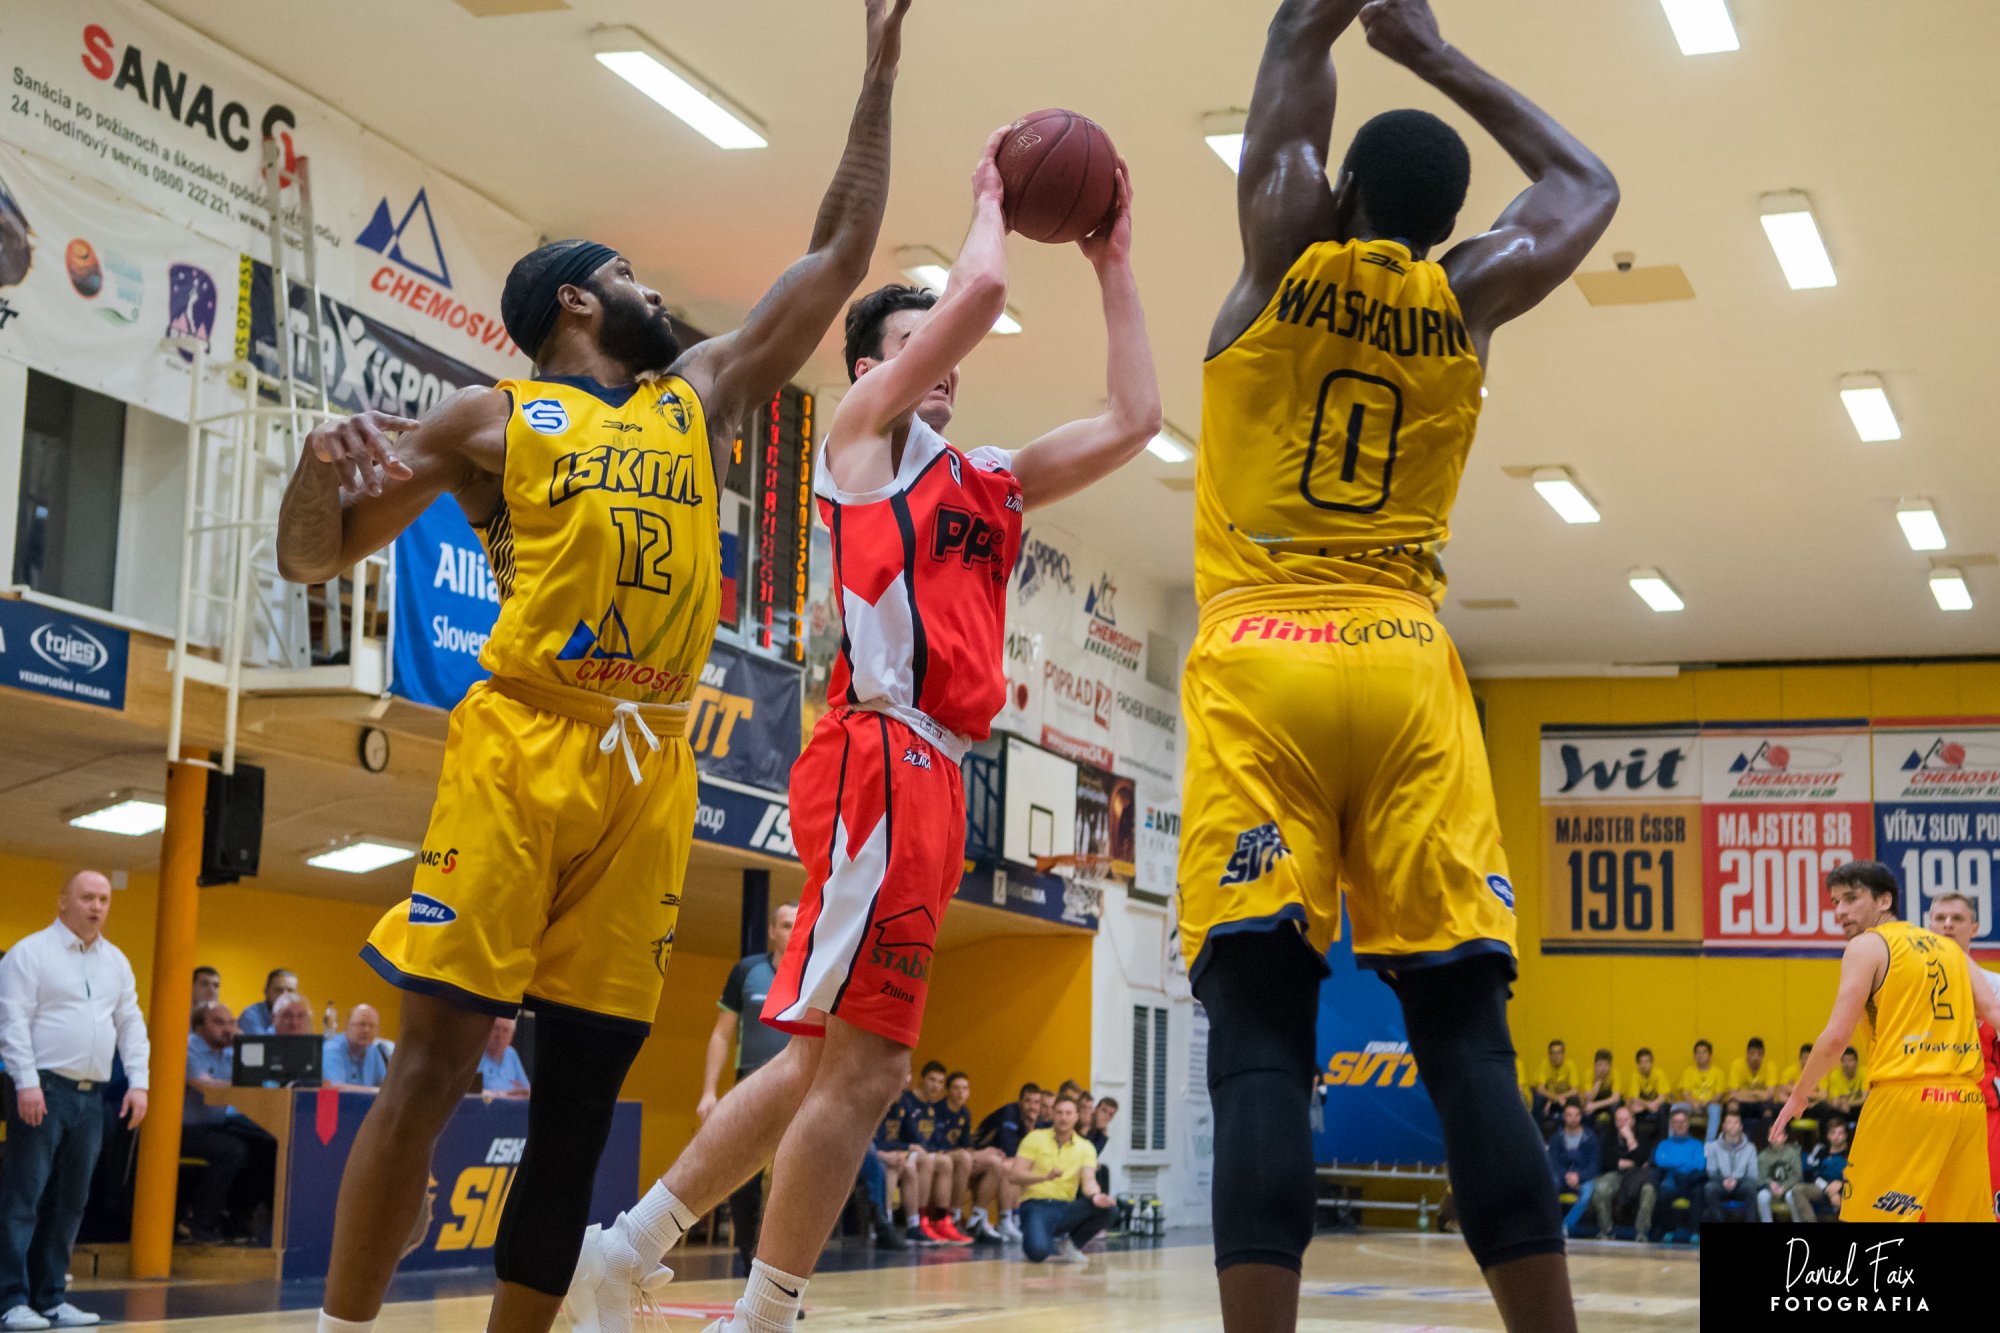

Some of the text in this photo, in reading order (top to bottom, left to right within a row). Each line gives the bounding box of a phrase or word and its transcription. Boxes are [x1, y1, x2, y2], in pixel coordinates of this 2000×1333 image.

[13, 66, 71, 109] Sanácia
[76, 102, 92, 120] po
[96, 112, 159, 155] požiaroch
[162, 149, 170, 161] a
[81, 24, 249, 152] SANAC
[11, 94, 29, 116] 24
[44, 109, 108, 158] hodinový
[152, 165, 184, 193] 0800
[188, 182, 208, 206] 222
[370, 266, 520, 357] CHEMOSVIT
[1276, 276, 1469, 357] WASHBURN
[1299, 368, 1403, 514] 0
[550, 446, 702, 507] ISKRA
[610, 507, 672, 595] 12
[1231, 615, 1434, 647] FlintGroup
[1044, 659, 1093, 706] POPRAD
[1558, 743, 1687, 792] Svit
[1737, 771, 1845, 786] CHEMOSVIT
[750, 803, 800, 857] IS
[1555, 811, 1687, 844] MAJSTER ČSSR
[1717, 812, 1852, 847] MAJSTER SR
[1929, 812, 1972, 842] SLOV.
[1568, 849, 1674, 932] 1961
[1901, 849, 2000, 938] 199
[880, 980, 915, 1004] Žilina
[1926, 958, 1955, 1020] 2
